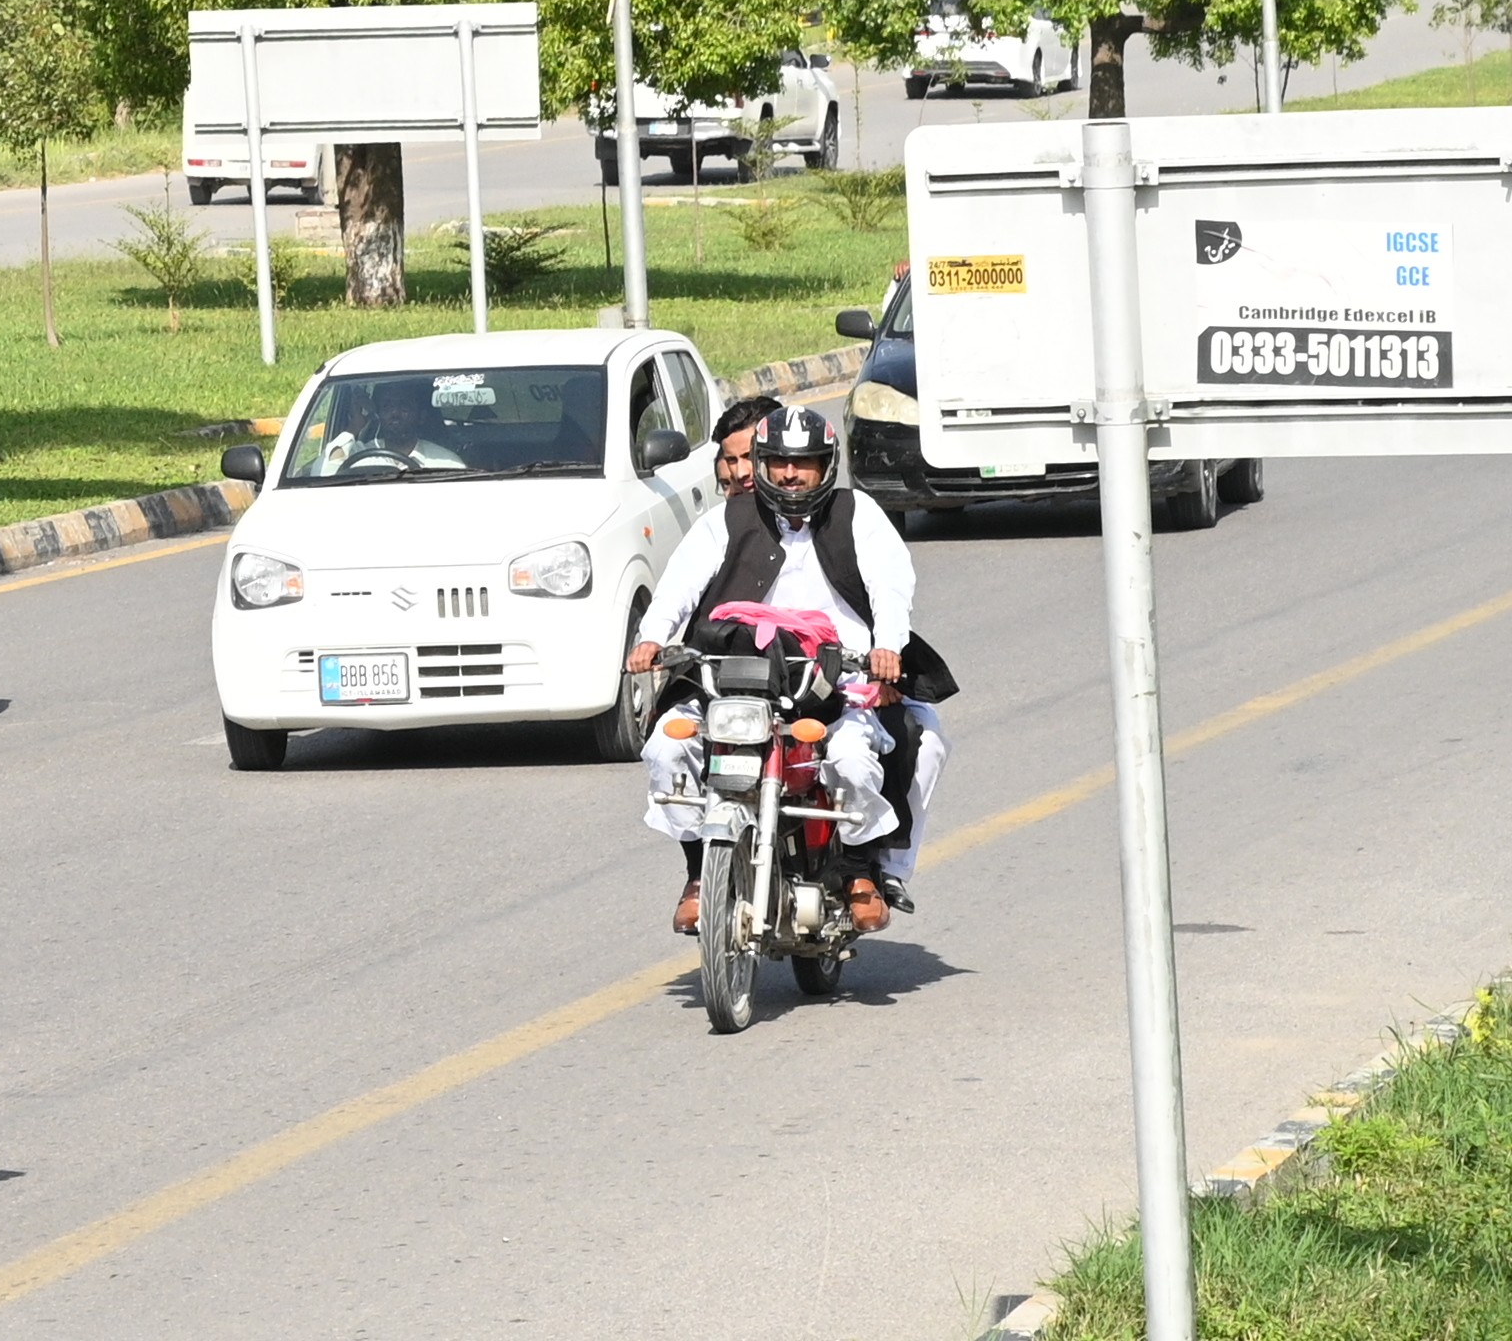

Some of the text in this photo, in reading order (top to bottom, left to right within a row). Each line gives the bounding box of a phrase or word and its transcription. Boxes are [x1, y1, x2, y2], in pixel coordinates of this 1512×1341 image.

[1386, 231, 1440, 253] IGCSE
[929, 268, 1023, 287] 0311-2000000
[1396, 265, 1431, 286] GCE
[1238, 305, 1339, 323] Cambridge
[1344, 308, 1414, 323] Edexcel
[1210, 330, 1440, 380] 0333-5011313
